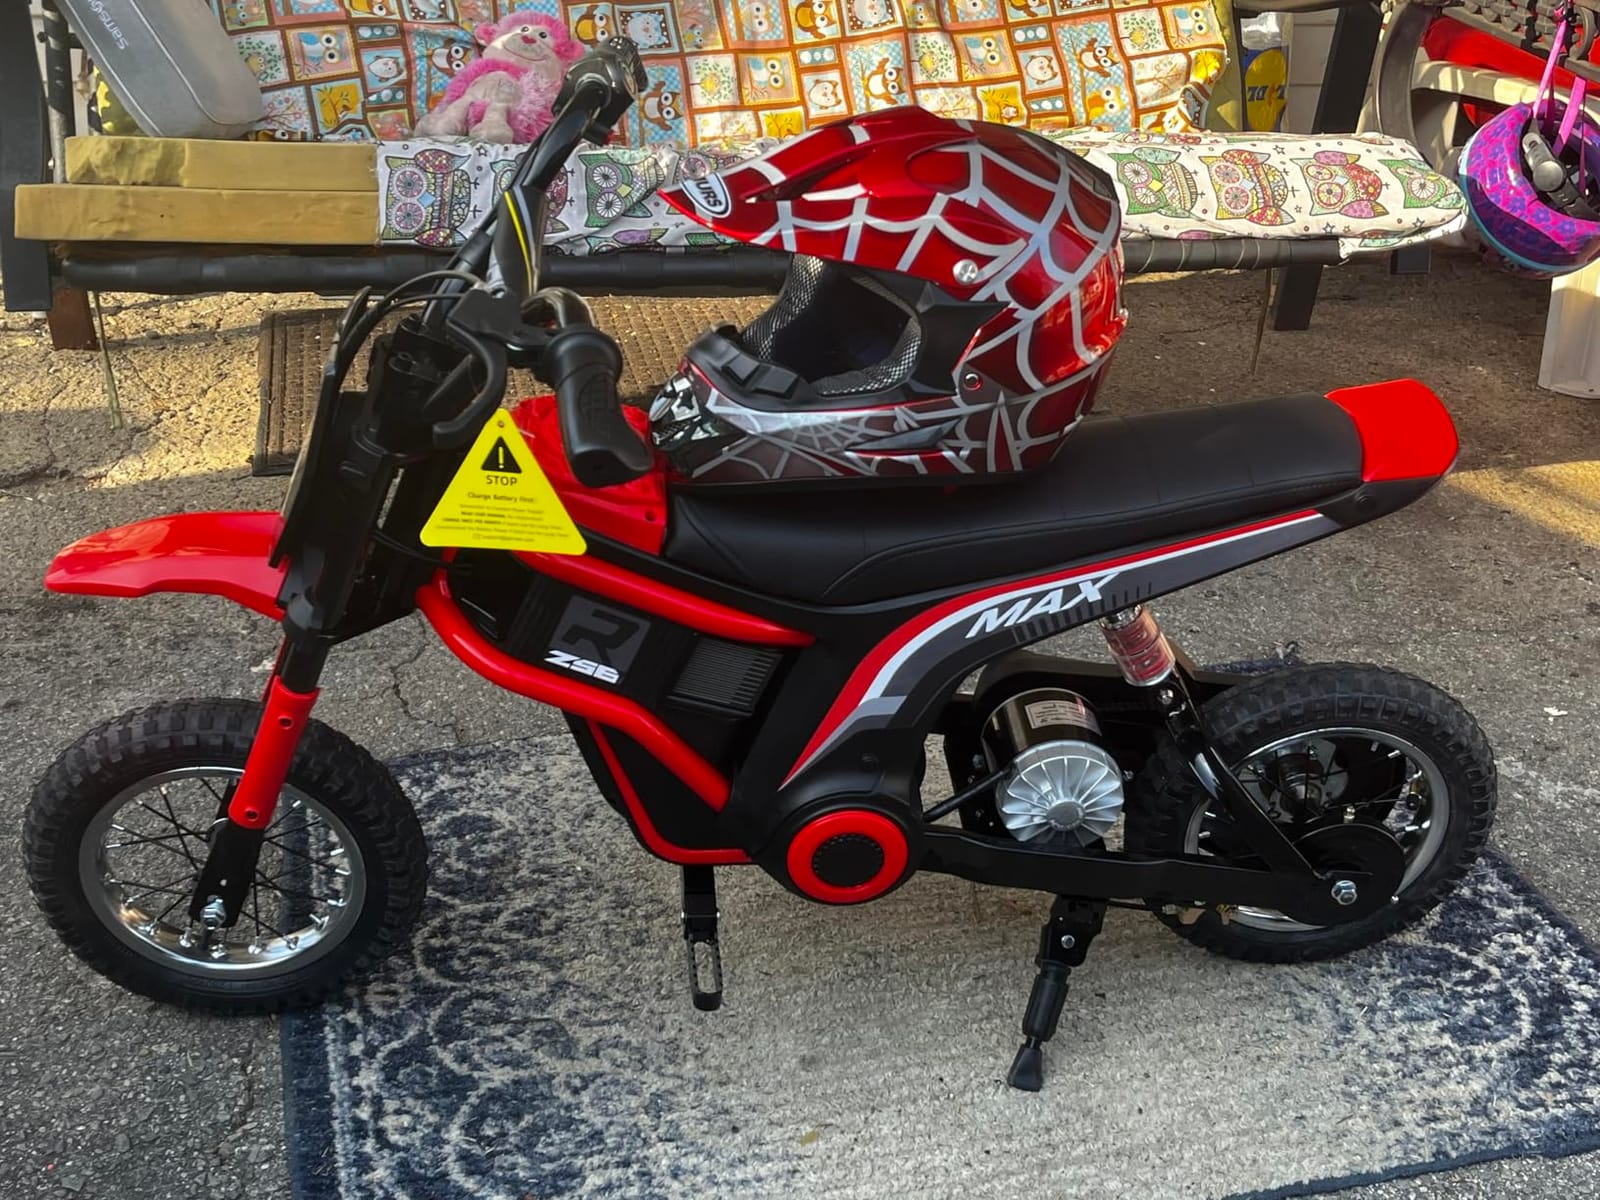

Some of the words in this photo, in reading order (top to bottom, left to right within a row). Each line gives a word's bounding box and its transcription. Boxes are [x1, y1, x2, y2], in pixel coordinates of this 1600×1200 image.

[486, 475, 518, 486] STOP
[468, 492, 491, 500] Charge
[493, 493, 518, 503] Battery
[965, 572, 1120, 638] MAX
